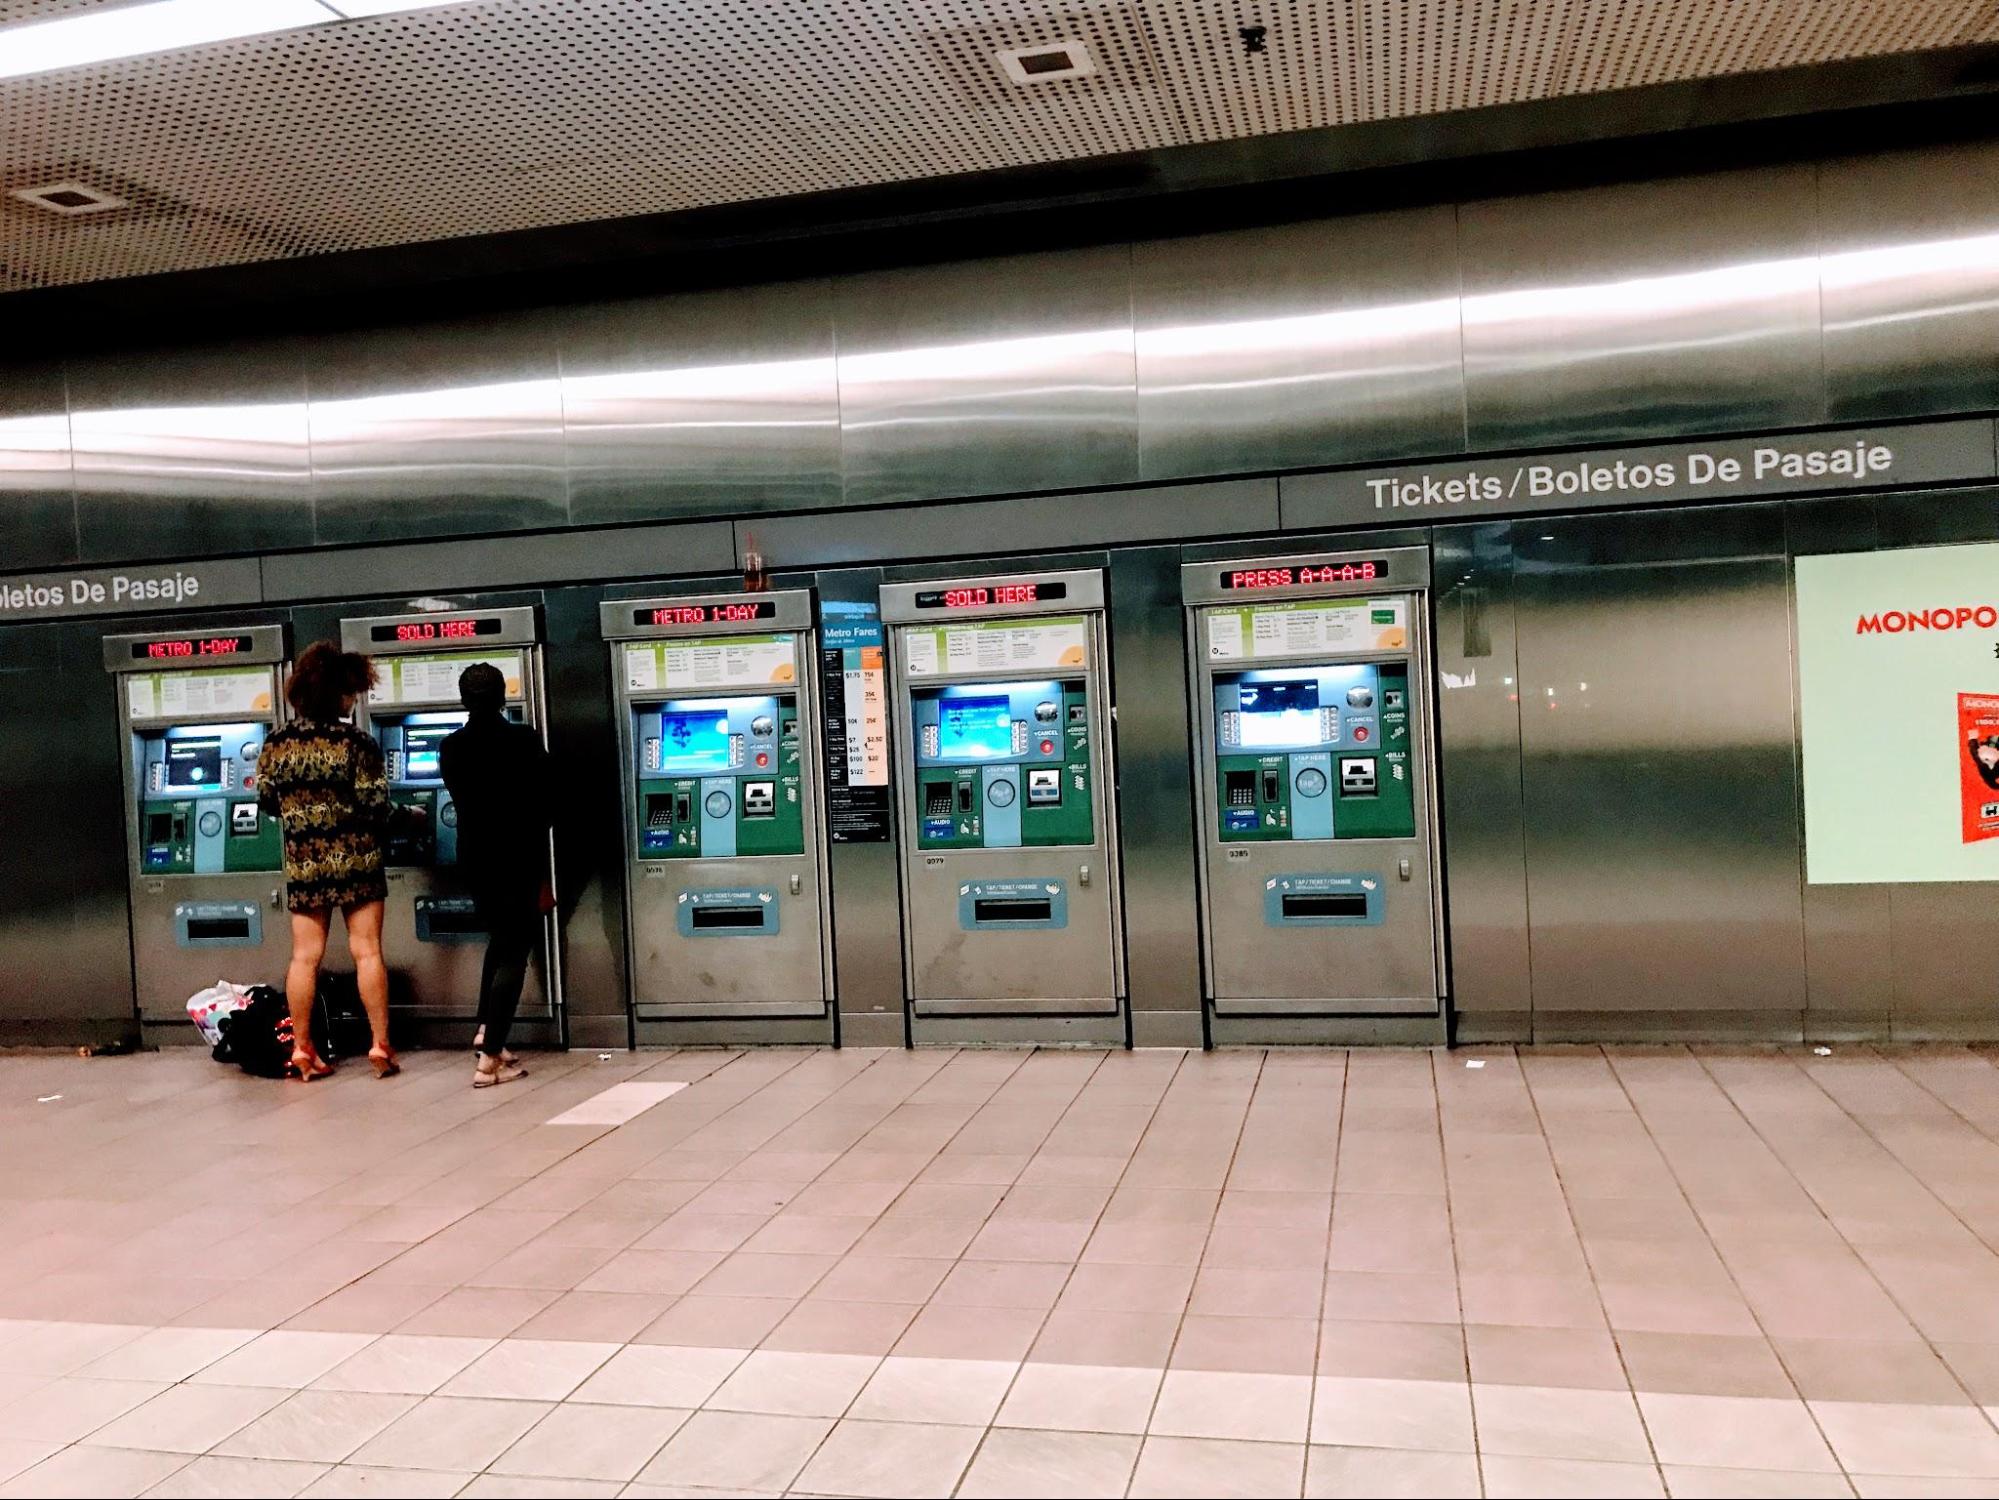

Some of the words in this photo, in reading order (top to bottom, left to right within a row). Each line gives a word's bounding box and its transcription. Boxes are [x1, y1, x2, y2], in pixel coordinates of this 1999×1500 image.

[1688, 454, 1741, 485] De
[1753, 441, 1893, 480] Pasaje
[1231, 568, 1292, 588] PRESS
[0, 583, 64, 608] letos
[71, 580, 105, 604] De
[113, 572, 199, 602] Pasaje
[944, 588, 988, 607] SOLD
[994, 585, 1037, 603] HERE
[653, 607, 705, 625] METRO
[712, 604, 759, 621] 1-DAY
[1856, 606, 1997, 634] MONOPO
[396, 622, 435, 641] SOLD
[439, 620, 477, 638] HERE
[825, 628, 852, 638] Metro
[854, 626, 878, 637] Fares
[147, 641, 193, 658] METRO
[199, 638, 239, 655] 1-DAY
